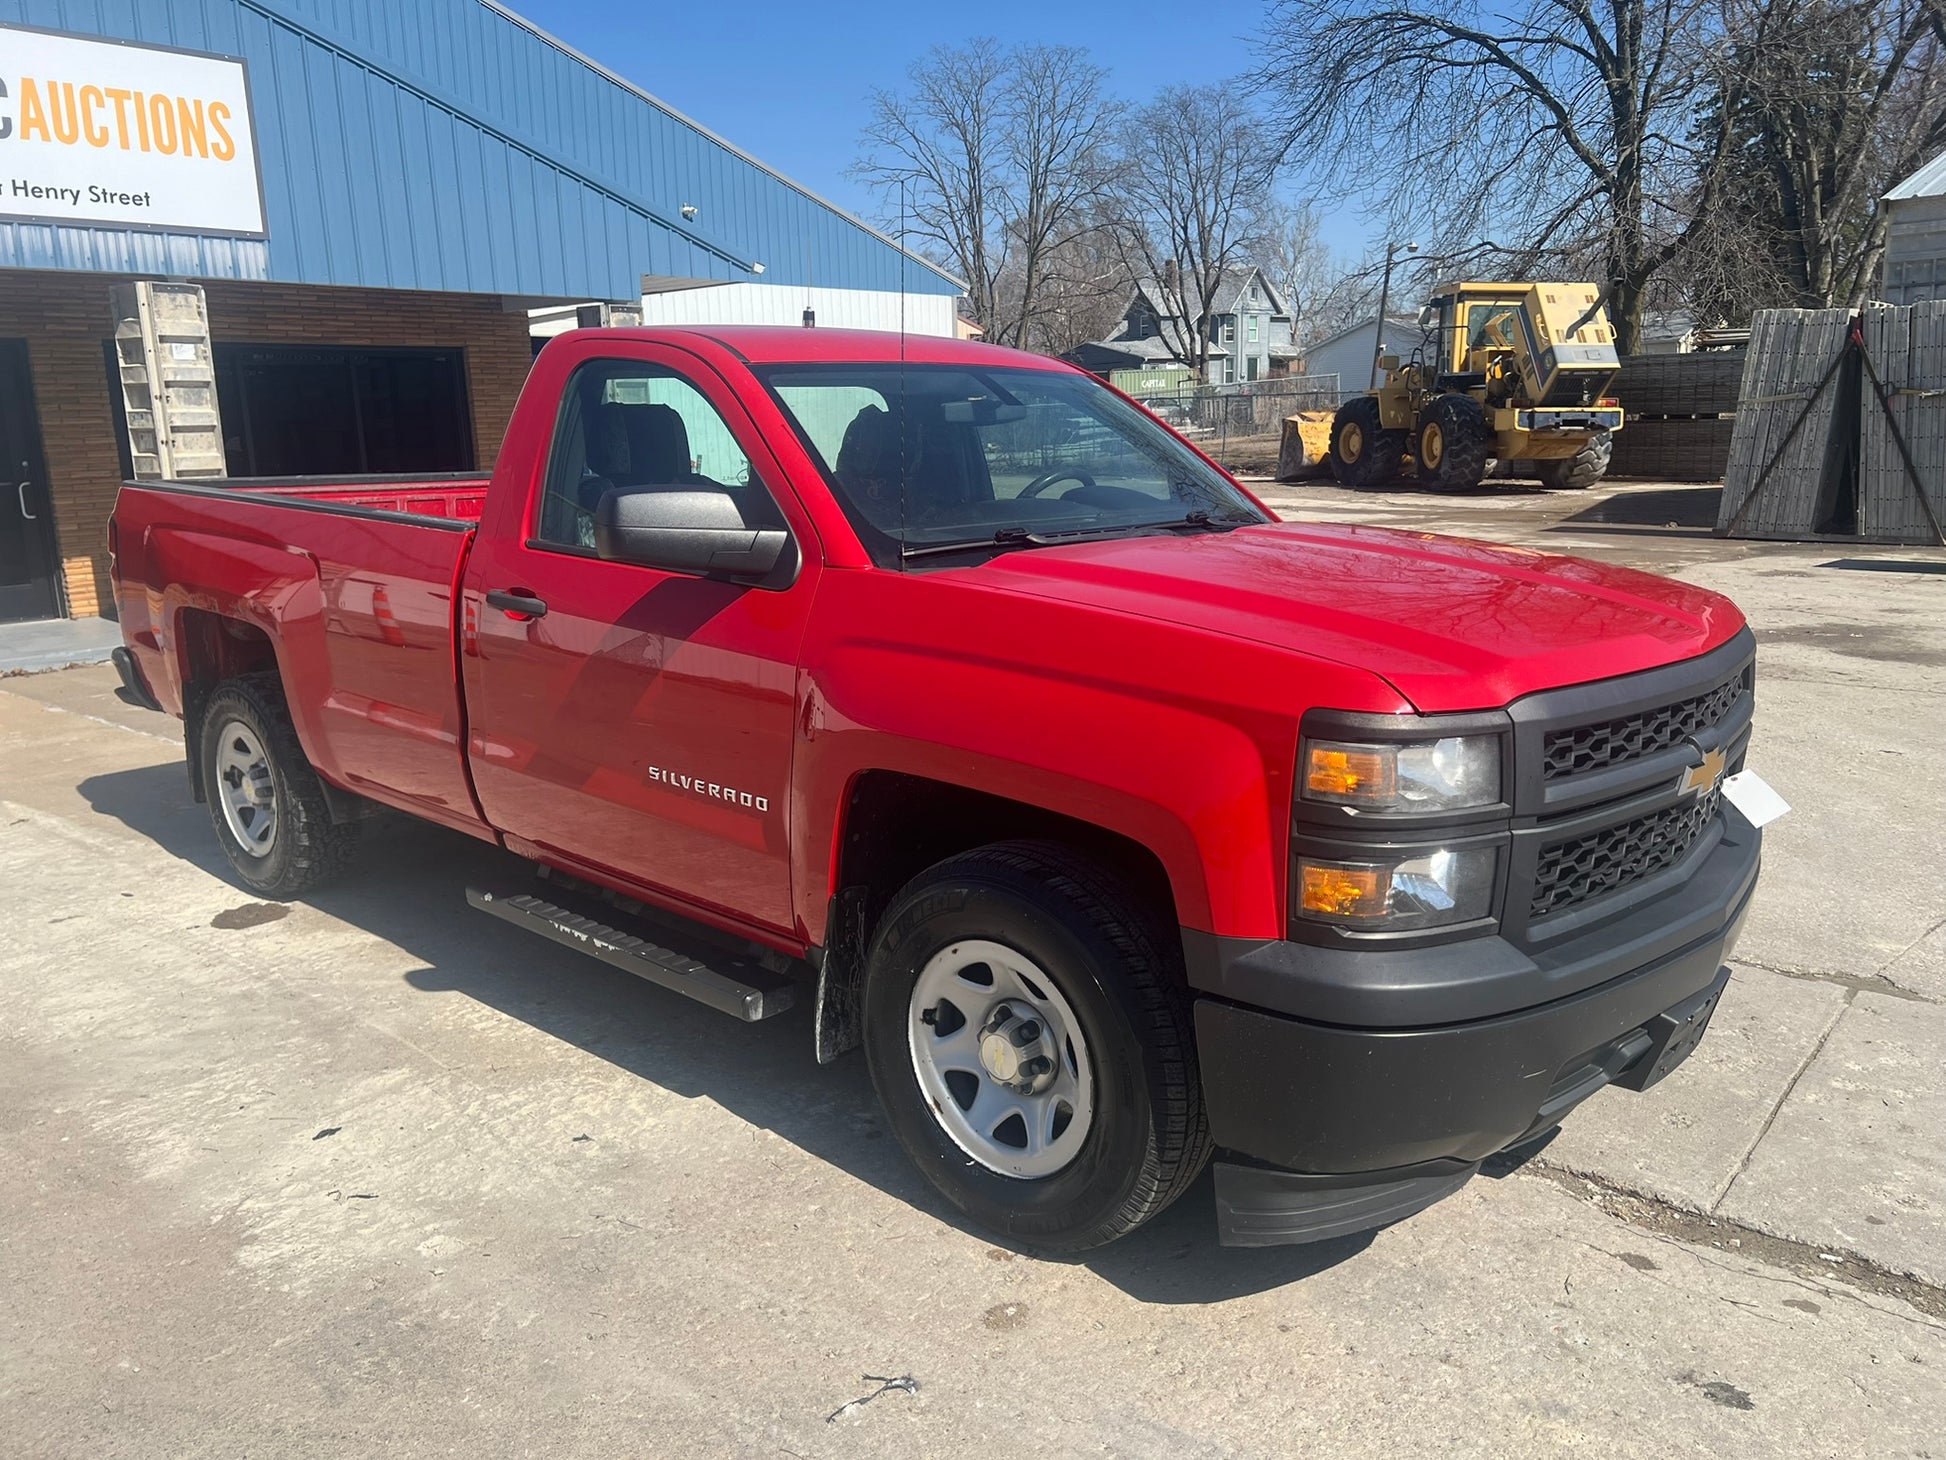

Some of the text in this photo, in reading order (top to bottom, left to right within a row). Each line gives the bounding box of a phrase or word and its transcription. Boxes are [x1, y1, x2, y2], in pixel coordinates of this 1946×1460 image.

[11, 179, 81, 206] Henry
[88, 185, 151, 207] Street
[648, 766, 769, 812] SILVERADO
